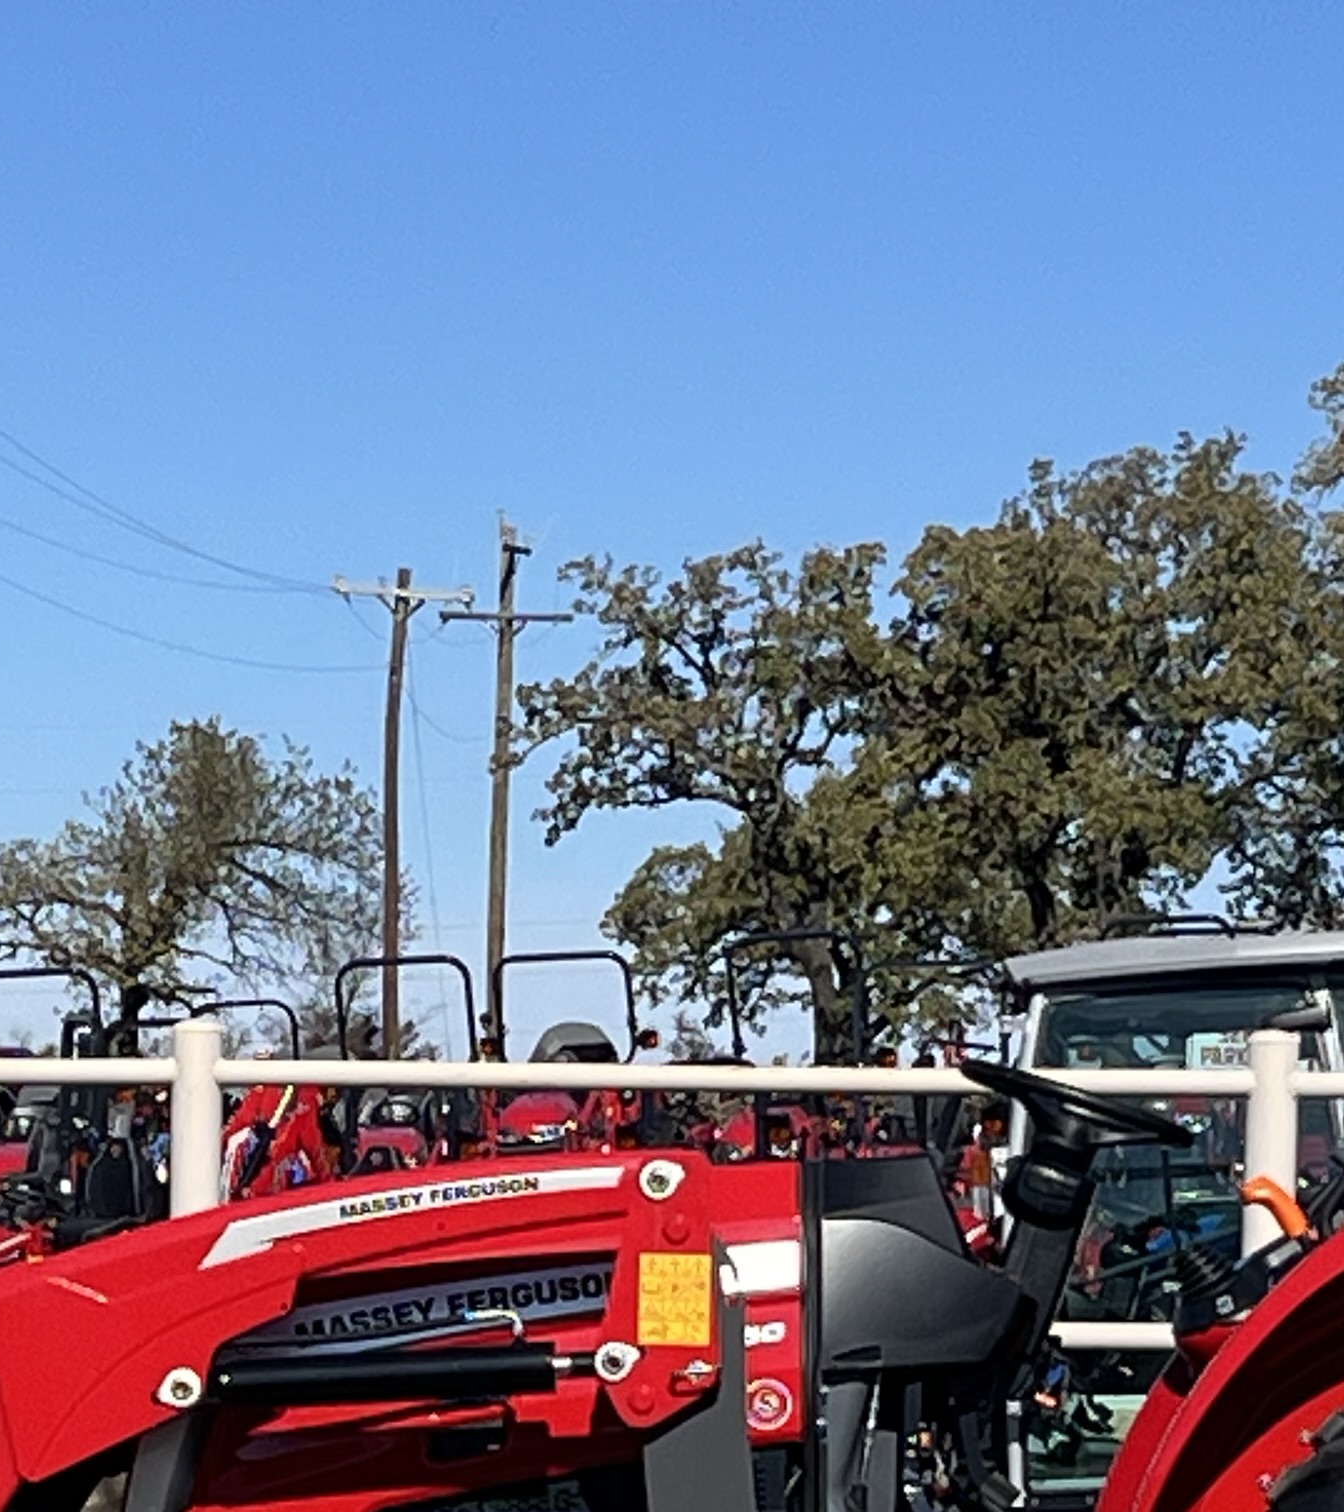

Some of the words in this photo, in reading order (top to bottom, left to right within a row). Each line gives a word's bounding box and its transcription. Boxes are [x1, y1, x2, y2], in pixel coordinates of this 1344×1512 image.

[340, 1191, 424, 1219] MASSEY
[430, 1177, 539, 1203] FERGUSON
[295, 1298, 433, 1336] MASSEY
